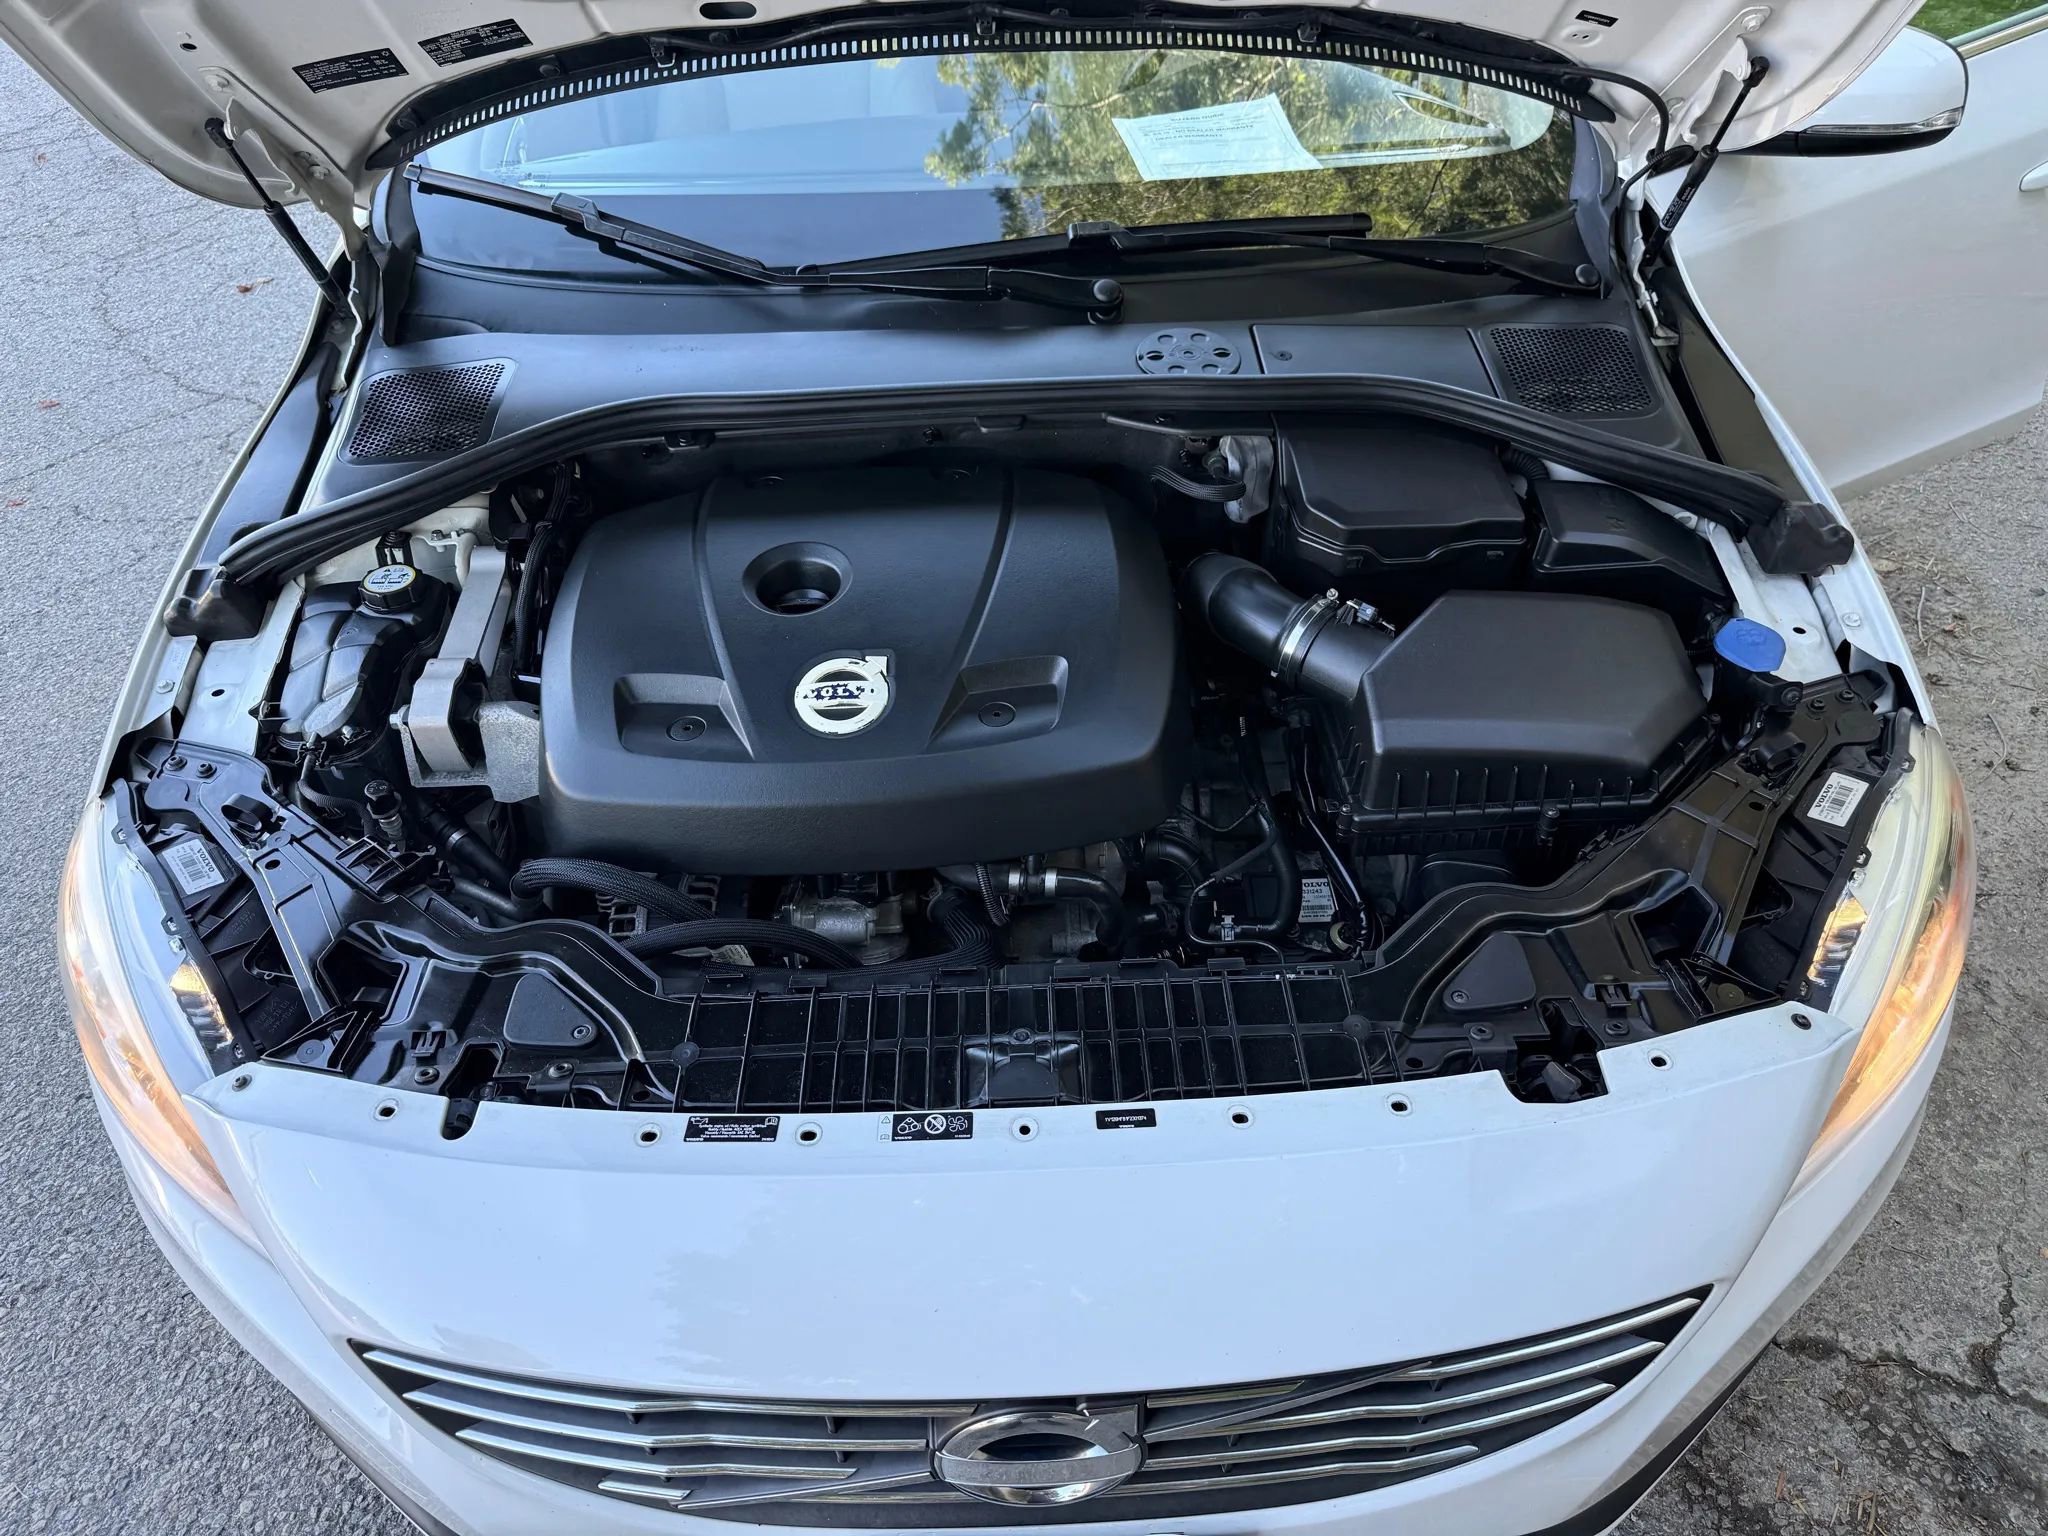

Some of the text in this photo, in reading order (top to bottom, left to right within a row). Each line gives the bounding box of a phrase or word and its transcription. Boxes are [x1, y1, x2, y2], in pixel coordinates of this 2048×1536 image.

[804, 685, 879, 700] VOLVO
[1814, 783, 1834, 808] VOLVO
[196, 847, 216, 873] VOLVO
